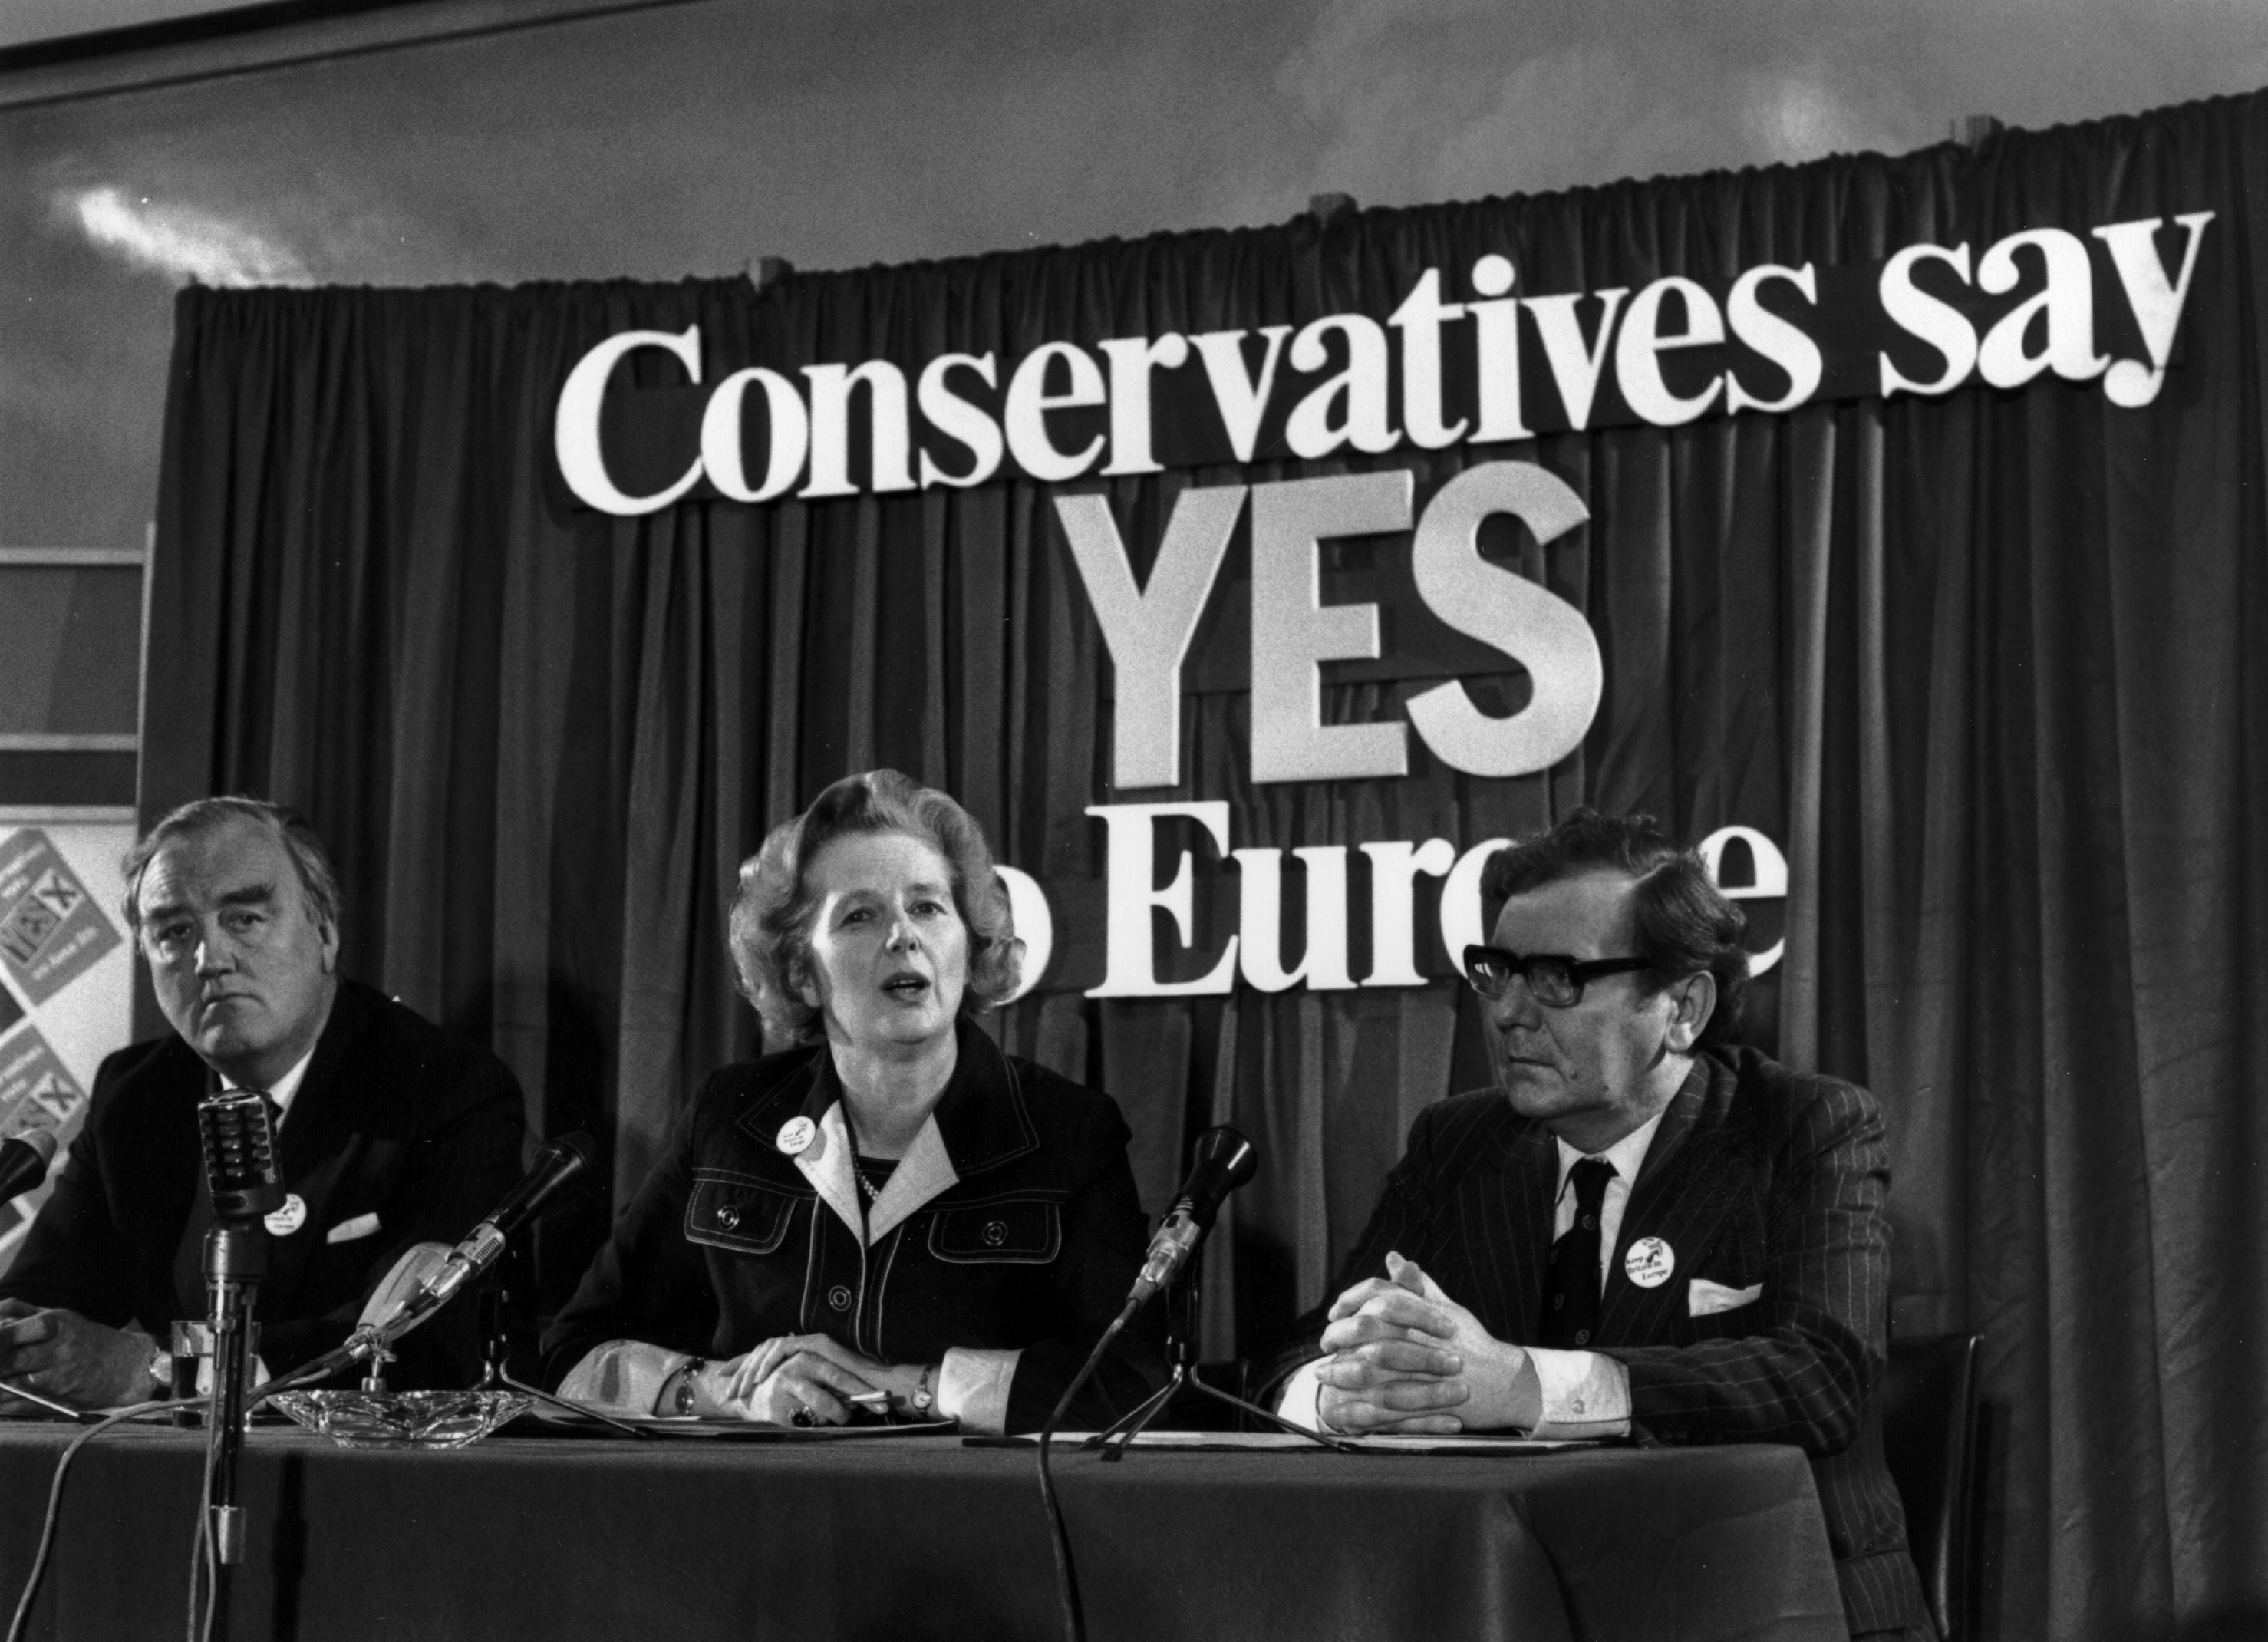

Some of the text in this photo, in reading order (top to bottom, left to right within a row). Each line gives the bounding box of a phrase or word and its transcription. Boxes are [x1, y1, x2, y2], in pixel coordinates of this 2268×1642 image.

[555, 212, 2214, 514] Conservatives say
[1054, 462, 1603, 787] YES
